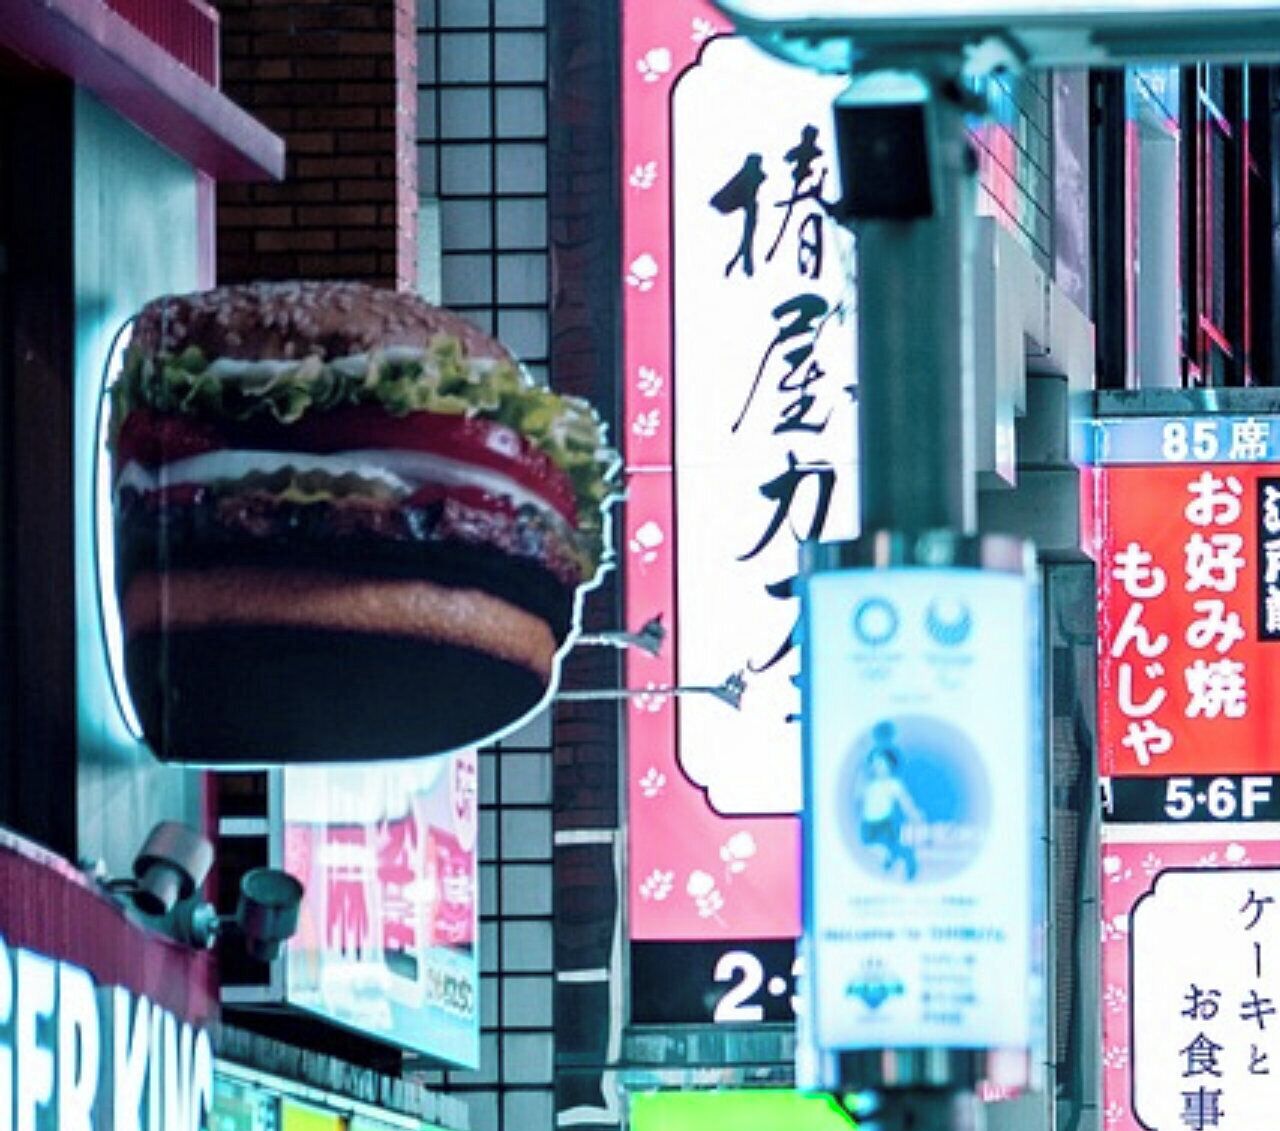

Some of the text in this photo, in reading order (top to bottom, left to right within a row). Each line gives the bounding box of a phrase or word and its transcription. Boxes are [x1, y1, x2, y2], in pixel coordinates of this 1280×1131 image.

[1111, 541, 1174, 766] もんじゃ
[1183, 471, 1247, 720] お好み焼
[1179, 983, 1224, 1131] お食事
[1239, 889, 1276, 1076] ケーキと
